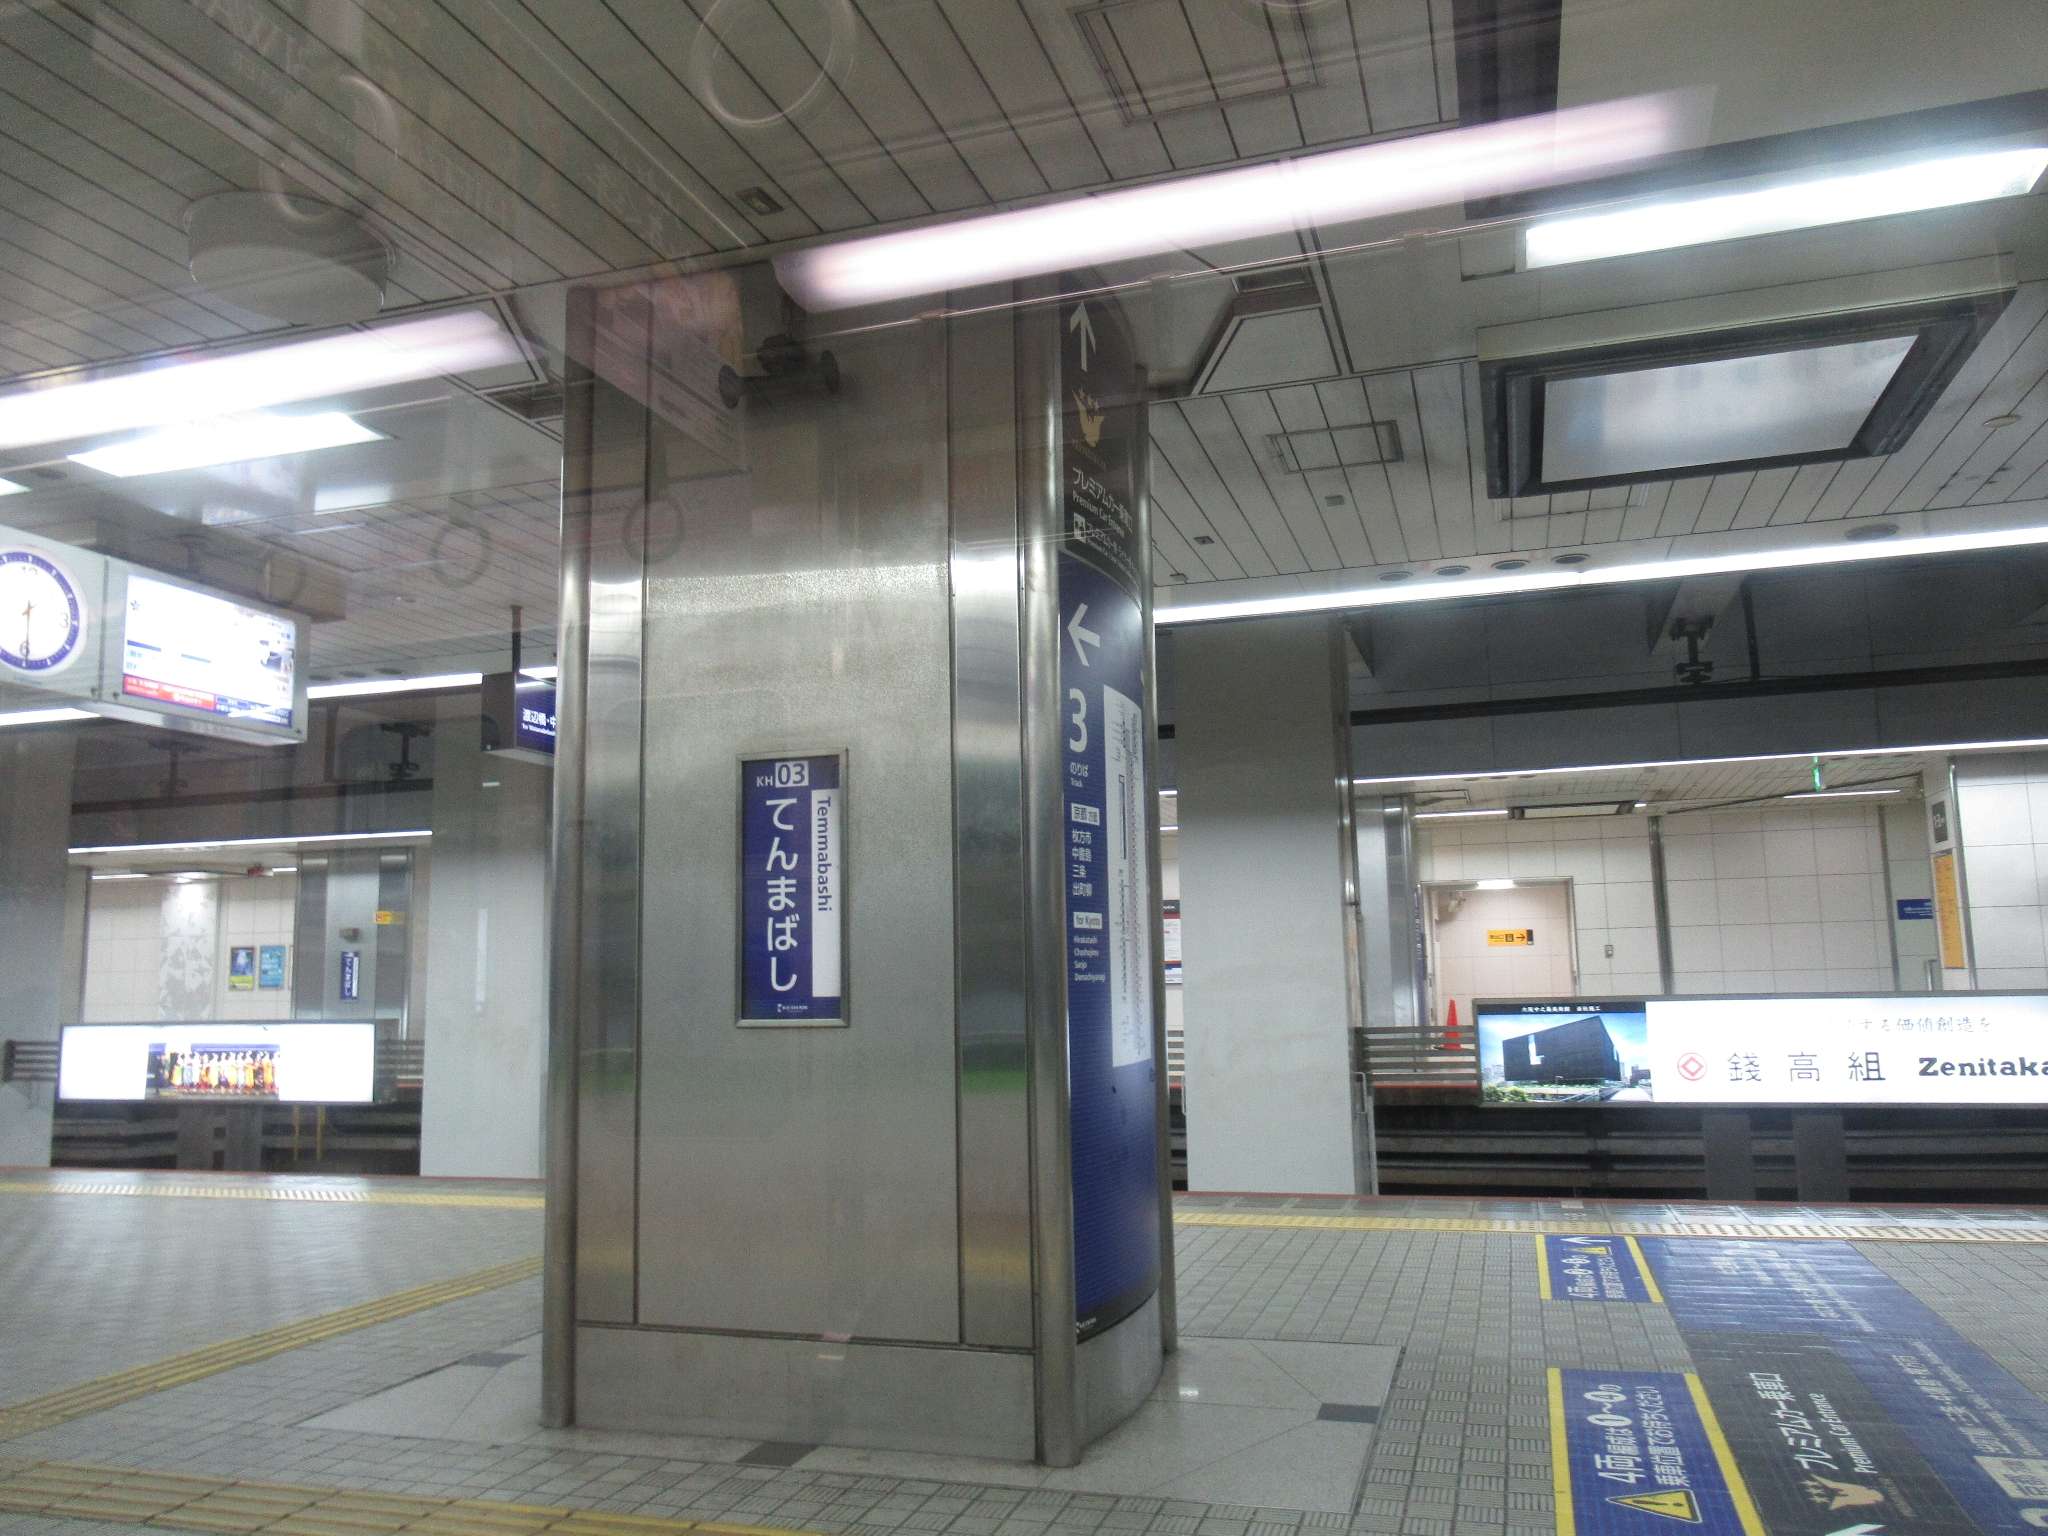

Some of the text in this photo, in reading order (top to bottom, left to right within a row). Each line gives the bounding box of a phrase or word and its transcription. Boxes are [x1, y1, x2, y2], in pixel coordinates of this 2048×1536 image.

[1069, 687, 1088, 753] 3
[756, 763, 806, 788] KH 03
[766, 798, 800, 992] てんまばし
[816, 796, 832, 912] Temmabashi
[1635, 1385, 1691, 1487] 乗車位置でお待ちください
[1749, 1372, 1839, 1470] プレミアムカー乗車口
[1808, 1392, 1879, 1474] Premium Car Entrance
